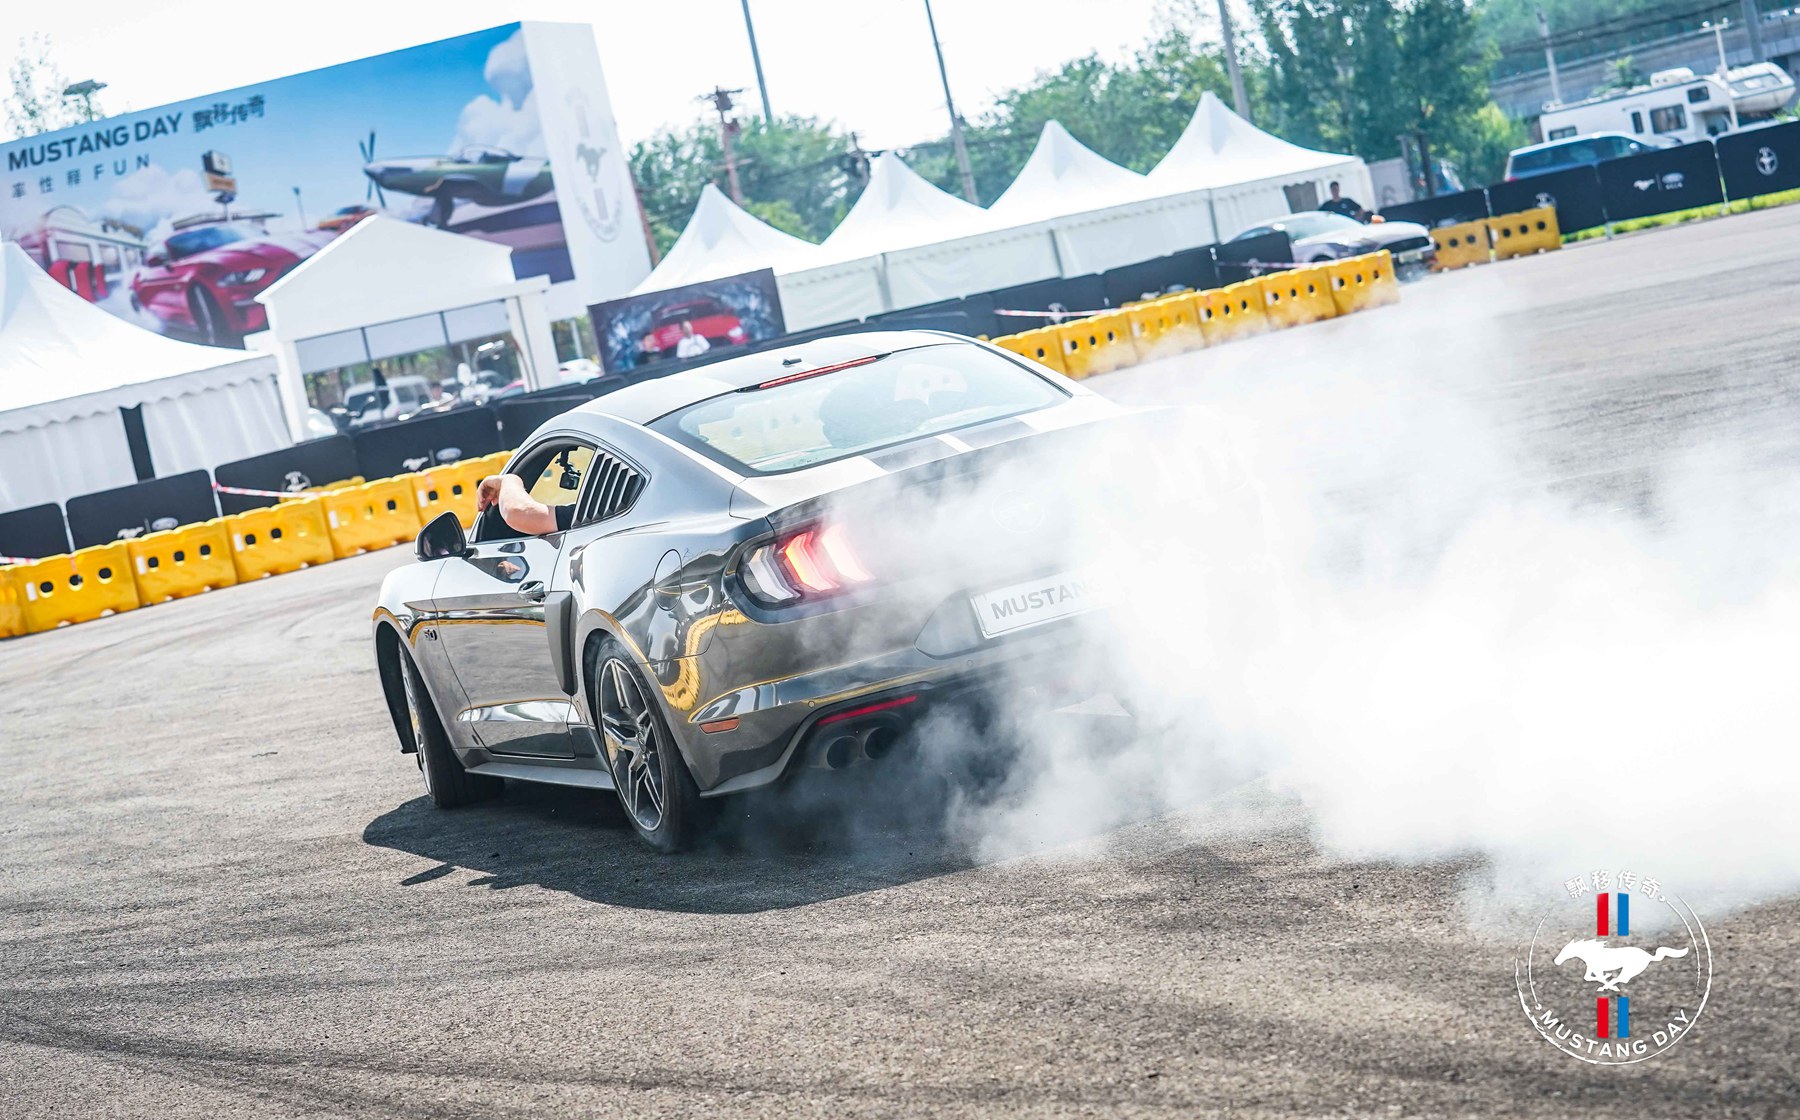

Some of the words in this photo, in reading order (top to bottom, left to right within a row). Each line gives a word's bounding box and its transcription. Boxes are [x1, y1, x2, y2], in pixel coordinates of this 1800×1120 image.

[8, 125, 129, 171] MUSTANG
[134, 112, 183, 142] DAY
[990, 578, 1102, 620] MUSTAN
